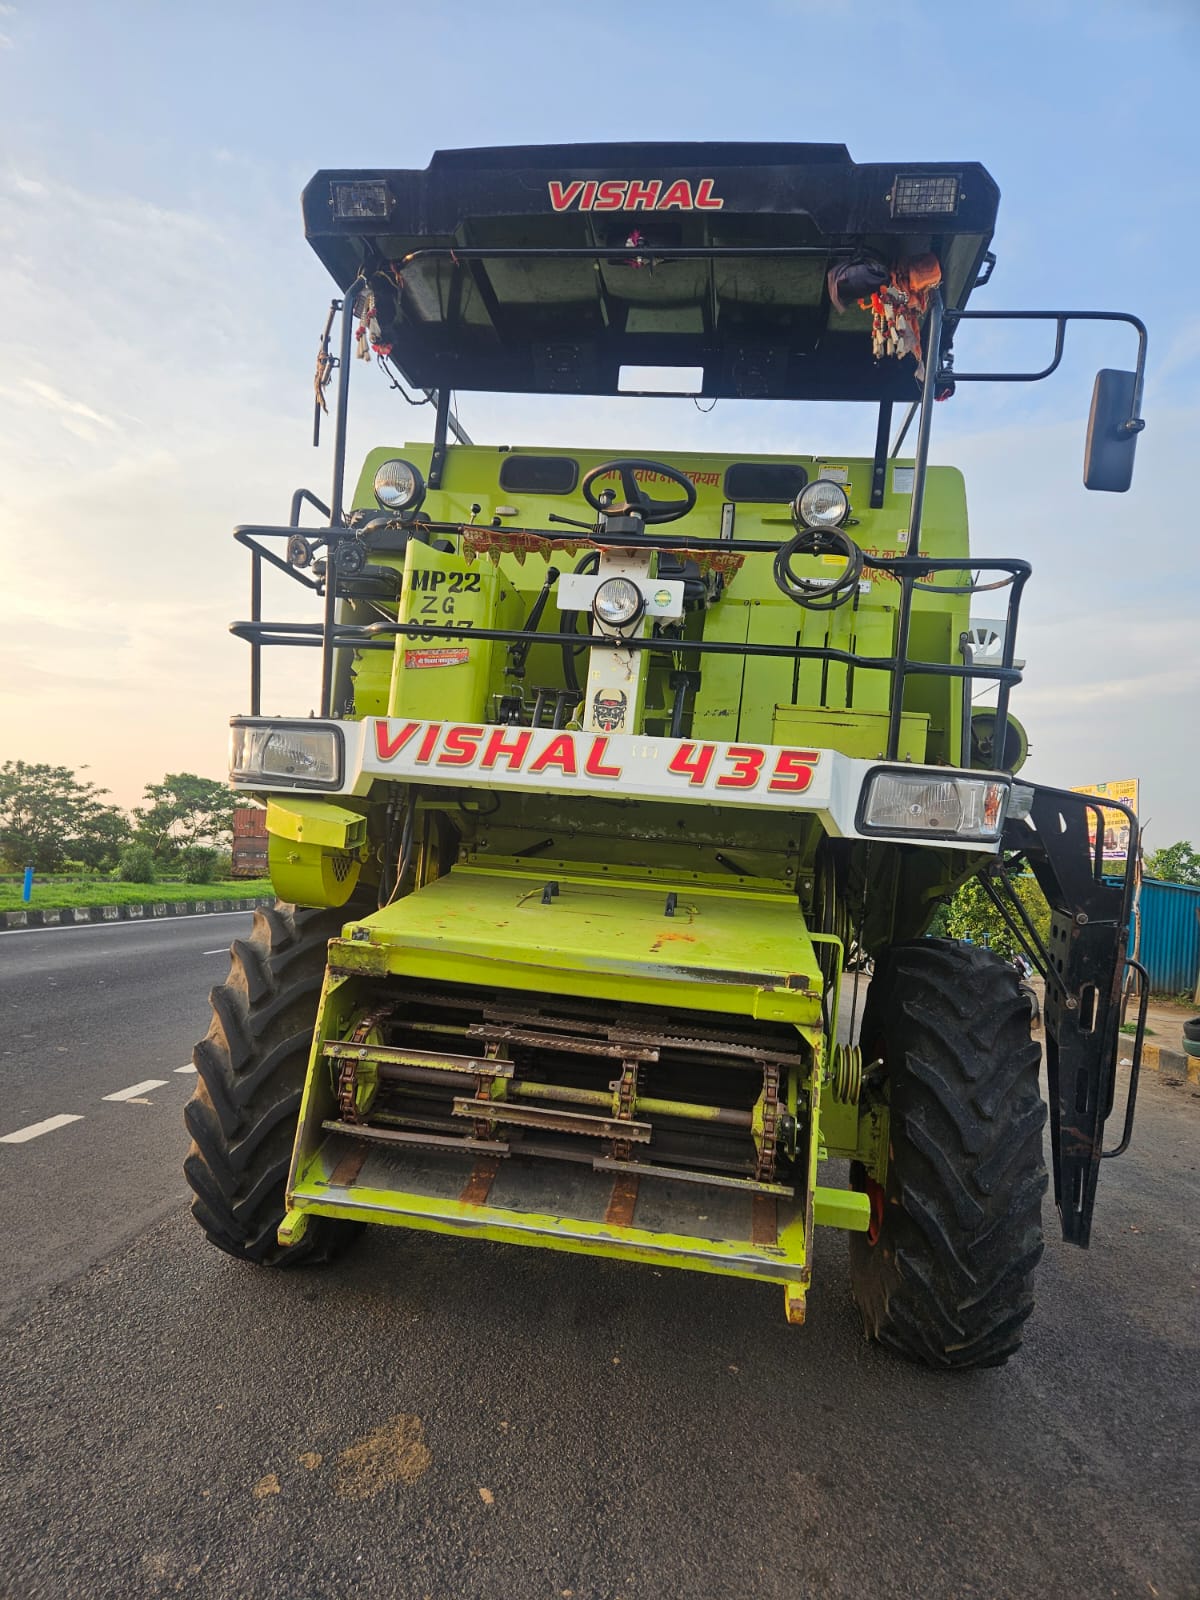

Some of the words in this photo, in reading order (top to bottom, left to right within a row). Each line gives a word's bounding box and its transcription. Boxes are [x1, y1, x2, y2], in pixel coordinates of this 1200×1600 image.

[548, 179, 724, 212] VISHAL
[373, 719, 622, 779] VISHAL
[667, 743, 820, 793] 435
